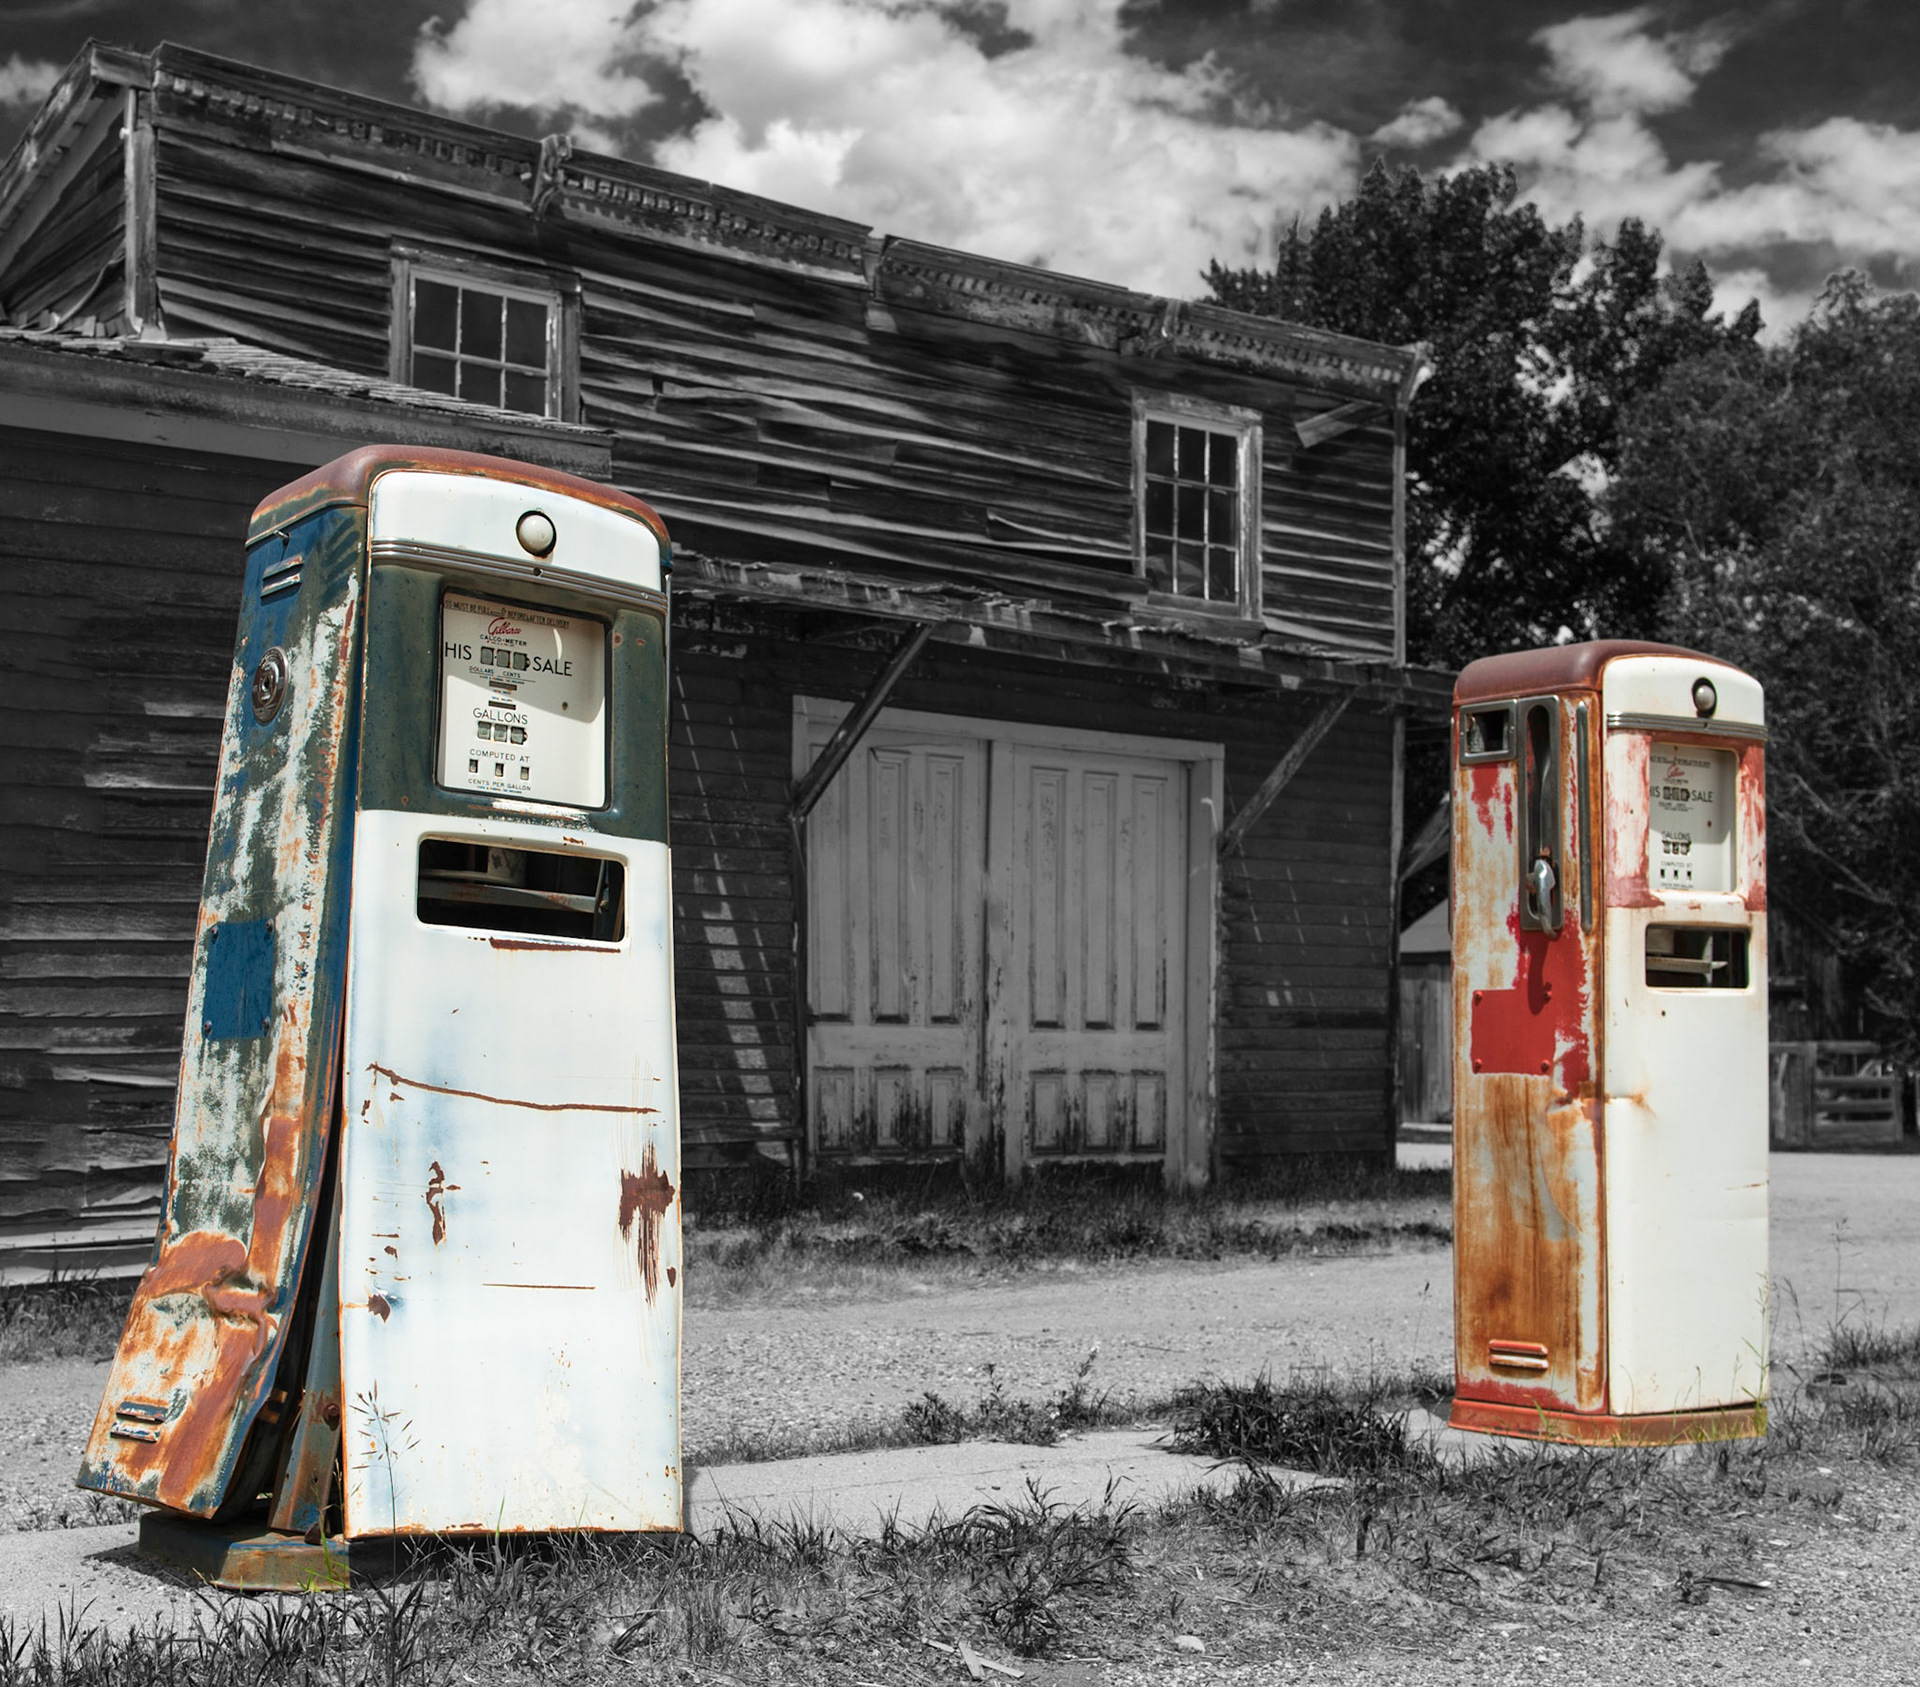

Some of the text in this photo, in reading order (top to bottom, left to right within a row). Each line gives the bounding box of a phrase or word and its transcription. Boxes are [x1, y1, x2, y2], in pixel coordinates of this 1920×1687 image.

[453, 602, 469, 611] MUST
[546, 617, 569, 629] DELIVERY
[480, 634, 527, 646] CALCO-METER
[469, 665, 521, 678] DOLLARS CENTS
[532, 656, 573, 677] SALE
[472, 707, 528, 725] GALLONS
[469, 748, 530, 763] COMPUTED AT
[468, 778, 490, 786] CENTS
[492, 780, 505, 788] PER
[506, 783, 532, 791] GALLON
[1691, 789, 1714, 803] SALE
